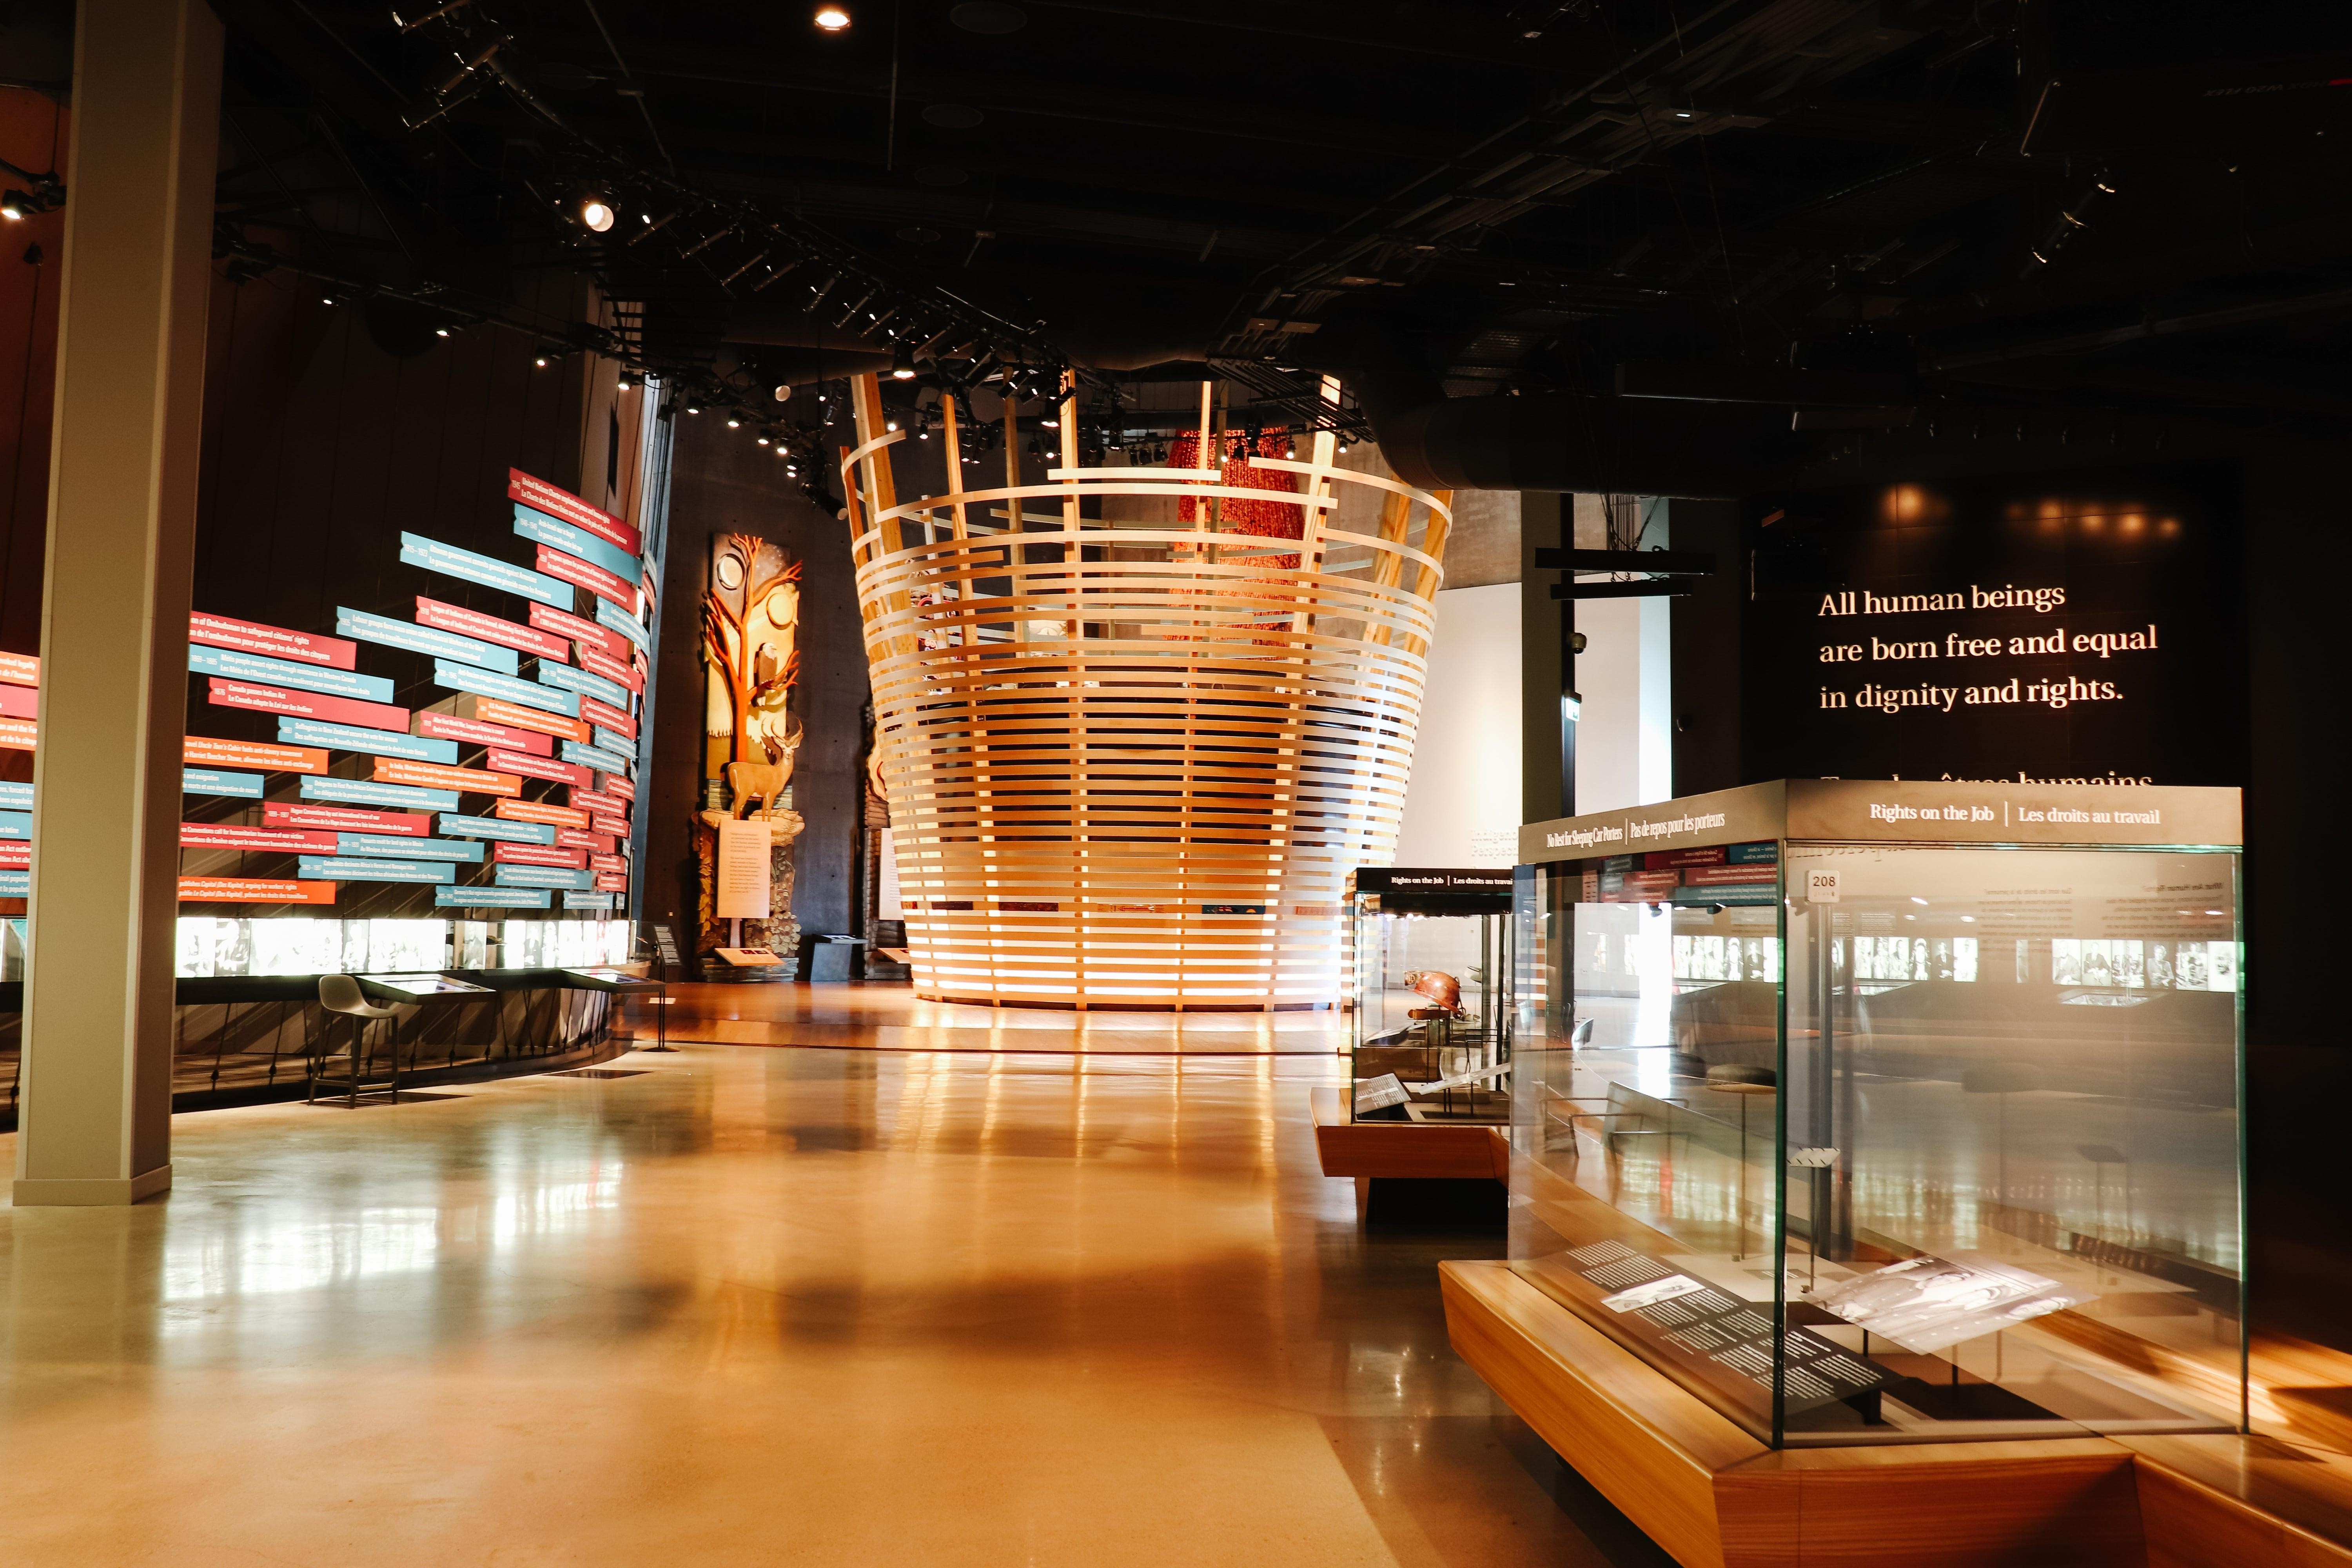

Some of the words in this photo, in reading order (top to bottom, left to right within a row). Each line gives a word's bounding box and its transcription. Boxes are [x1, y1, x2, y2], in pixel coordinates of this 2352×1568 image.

[1818, 592, 1857, 615] All
[1864, 591, 1965, 613] human
[1971, 585, 2065, 612] beings
[205, 619, 240, 631] Ombudsman
[247, 628, 273, 637] safeguard
[273, 632, 293, 641] citizens'
[293, 635, 309, 645] rights
[254, 641, 277, 651] protéger
[285, 646, 300, 654] droits
[309, 650, 330, 660] citoyens
[1820, 644, 1863, 662] are
[1872, 637, 1938, 659] born
[1945, 633, 2001, 657] free
[2009, 629, 2066, 654] and
[2073, 625, 2158, 657] equal
[229, 684, 246, 693] Canada
[1820, 686, 1847, 708] in
[1855, 684, 1958, 713] dignity
[1964, 679, 2020, 703] and
[2027, 676, 2123, 708] rights.
[234, 695, 252, 704] Canada
[1870, 804, 1917, 822] Rights
[1920, 809, 1940, 819] on
[1943, 805, 1968, 820] the
[1970, 806, 1994, 822] Job
[2018, 807, 2044, 821] Les
[2047, 808, 2089, 822] droits
[2092, 812, 2111, 822] au
[2113, 810, 2160, 824] travail
[1630, 822, 1641, 838] Pas
[1641, 820, 1650, 836] de
[1649, 822, 1667, 839] repos
[1667, 820, 1683, 838] pour
[1683, 814, 1694, 831] les
[1694, 813, 1725, 834] porteurs
[1546, 834, 1555, 847] No
[1554, 833, 1564, 846] Rest
[1572, 828, 1594, 848] Sleeping
[1593, 828, 1602, 842] Car
[1602, 826, 1622, 841] Porters
[1813, 876, 1836, 887] 208
